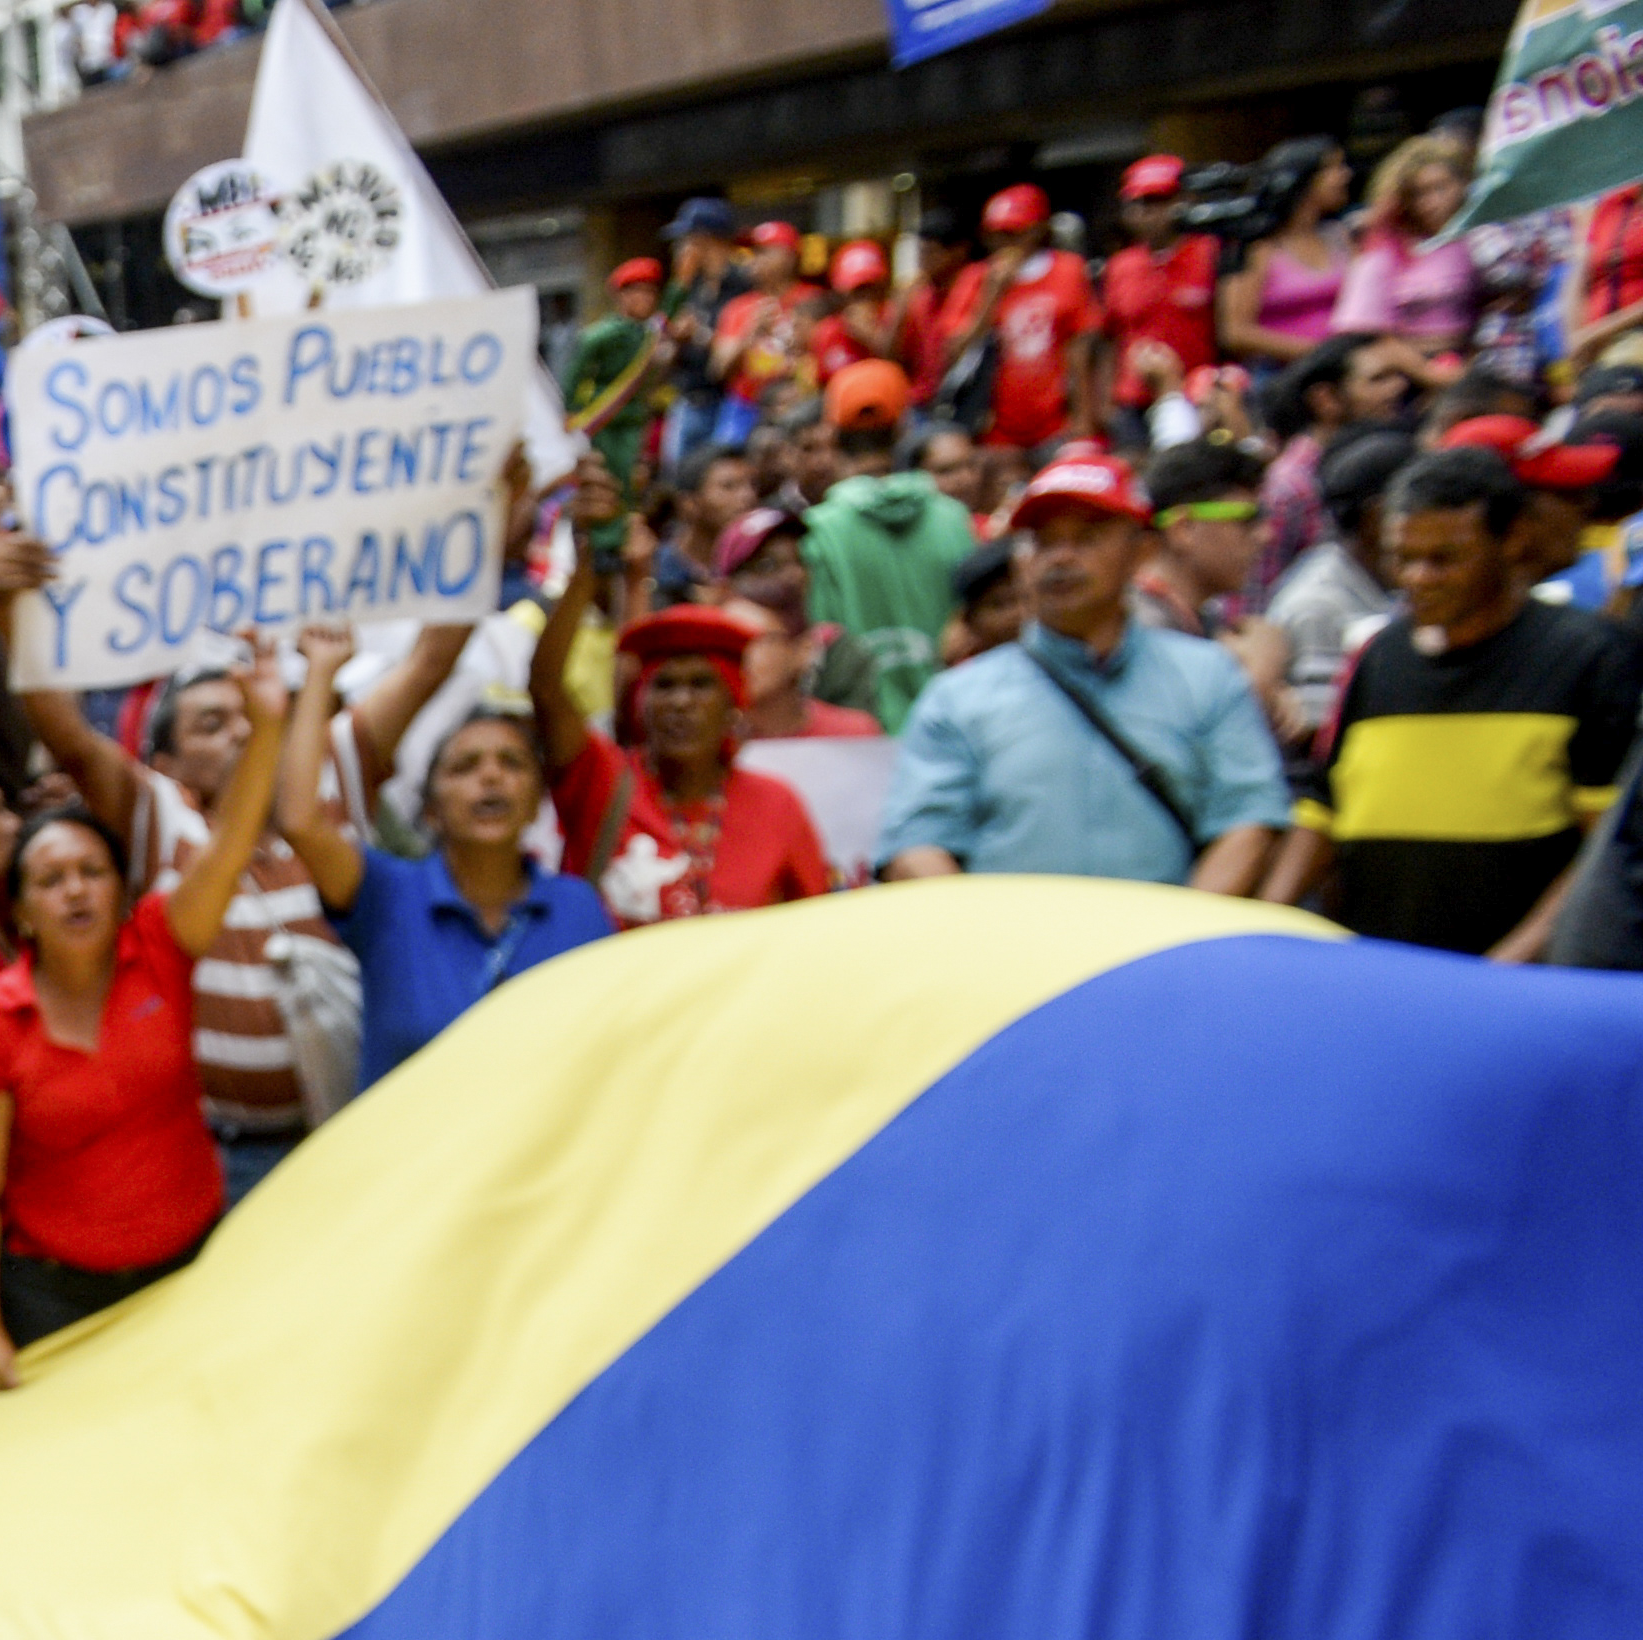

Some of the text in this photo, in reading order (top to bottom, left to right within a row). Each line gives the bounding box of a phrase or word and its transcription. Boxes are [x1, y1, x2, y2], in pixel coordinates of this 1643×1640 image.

[43, 323, 504, 452] SOMOS PUEBLO
[34, 415, 495, 554] CONSTITUYENTE
[43, 509, 485, 669] Y SOBERANO
